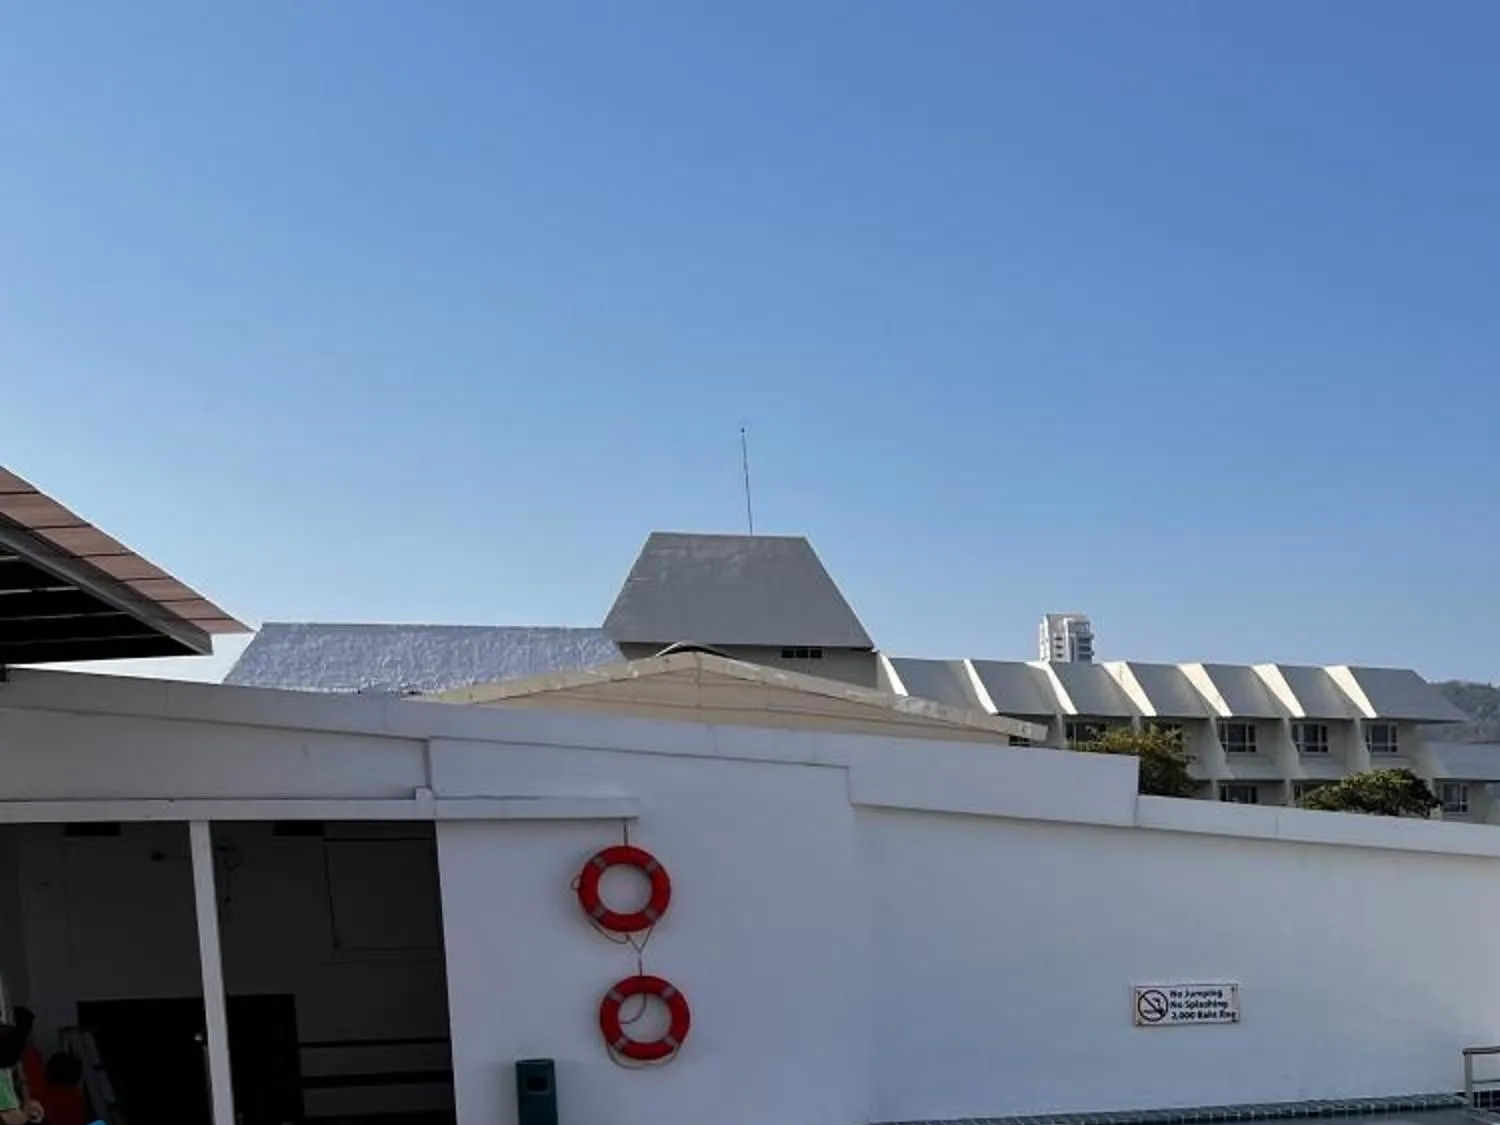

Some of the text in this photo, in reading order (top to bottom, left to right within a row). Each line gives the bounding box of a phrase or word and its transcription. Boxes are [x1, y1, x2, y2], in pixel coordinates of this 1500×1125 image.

[1170, 989, 1223, 999] No Jumping
[1170, 999, 1228, 1010] No Splashing
